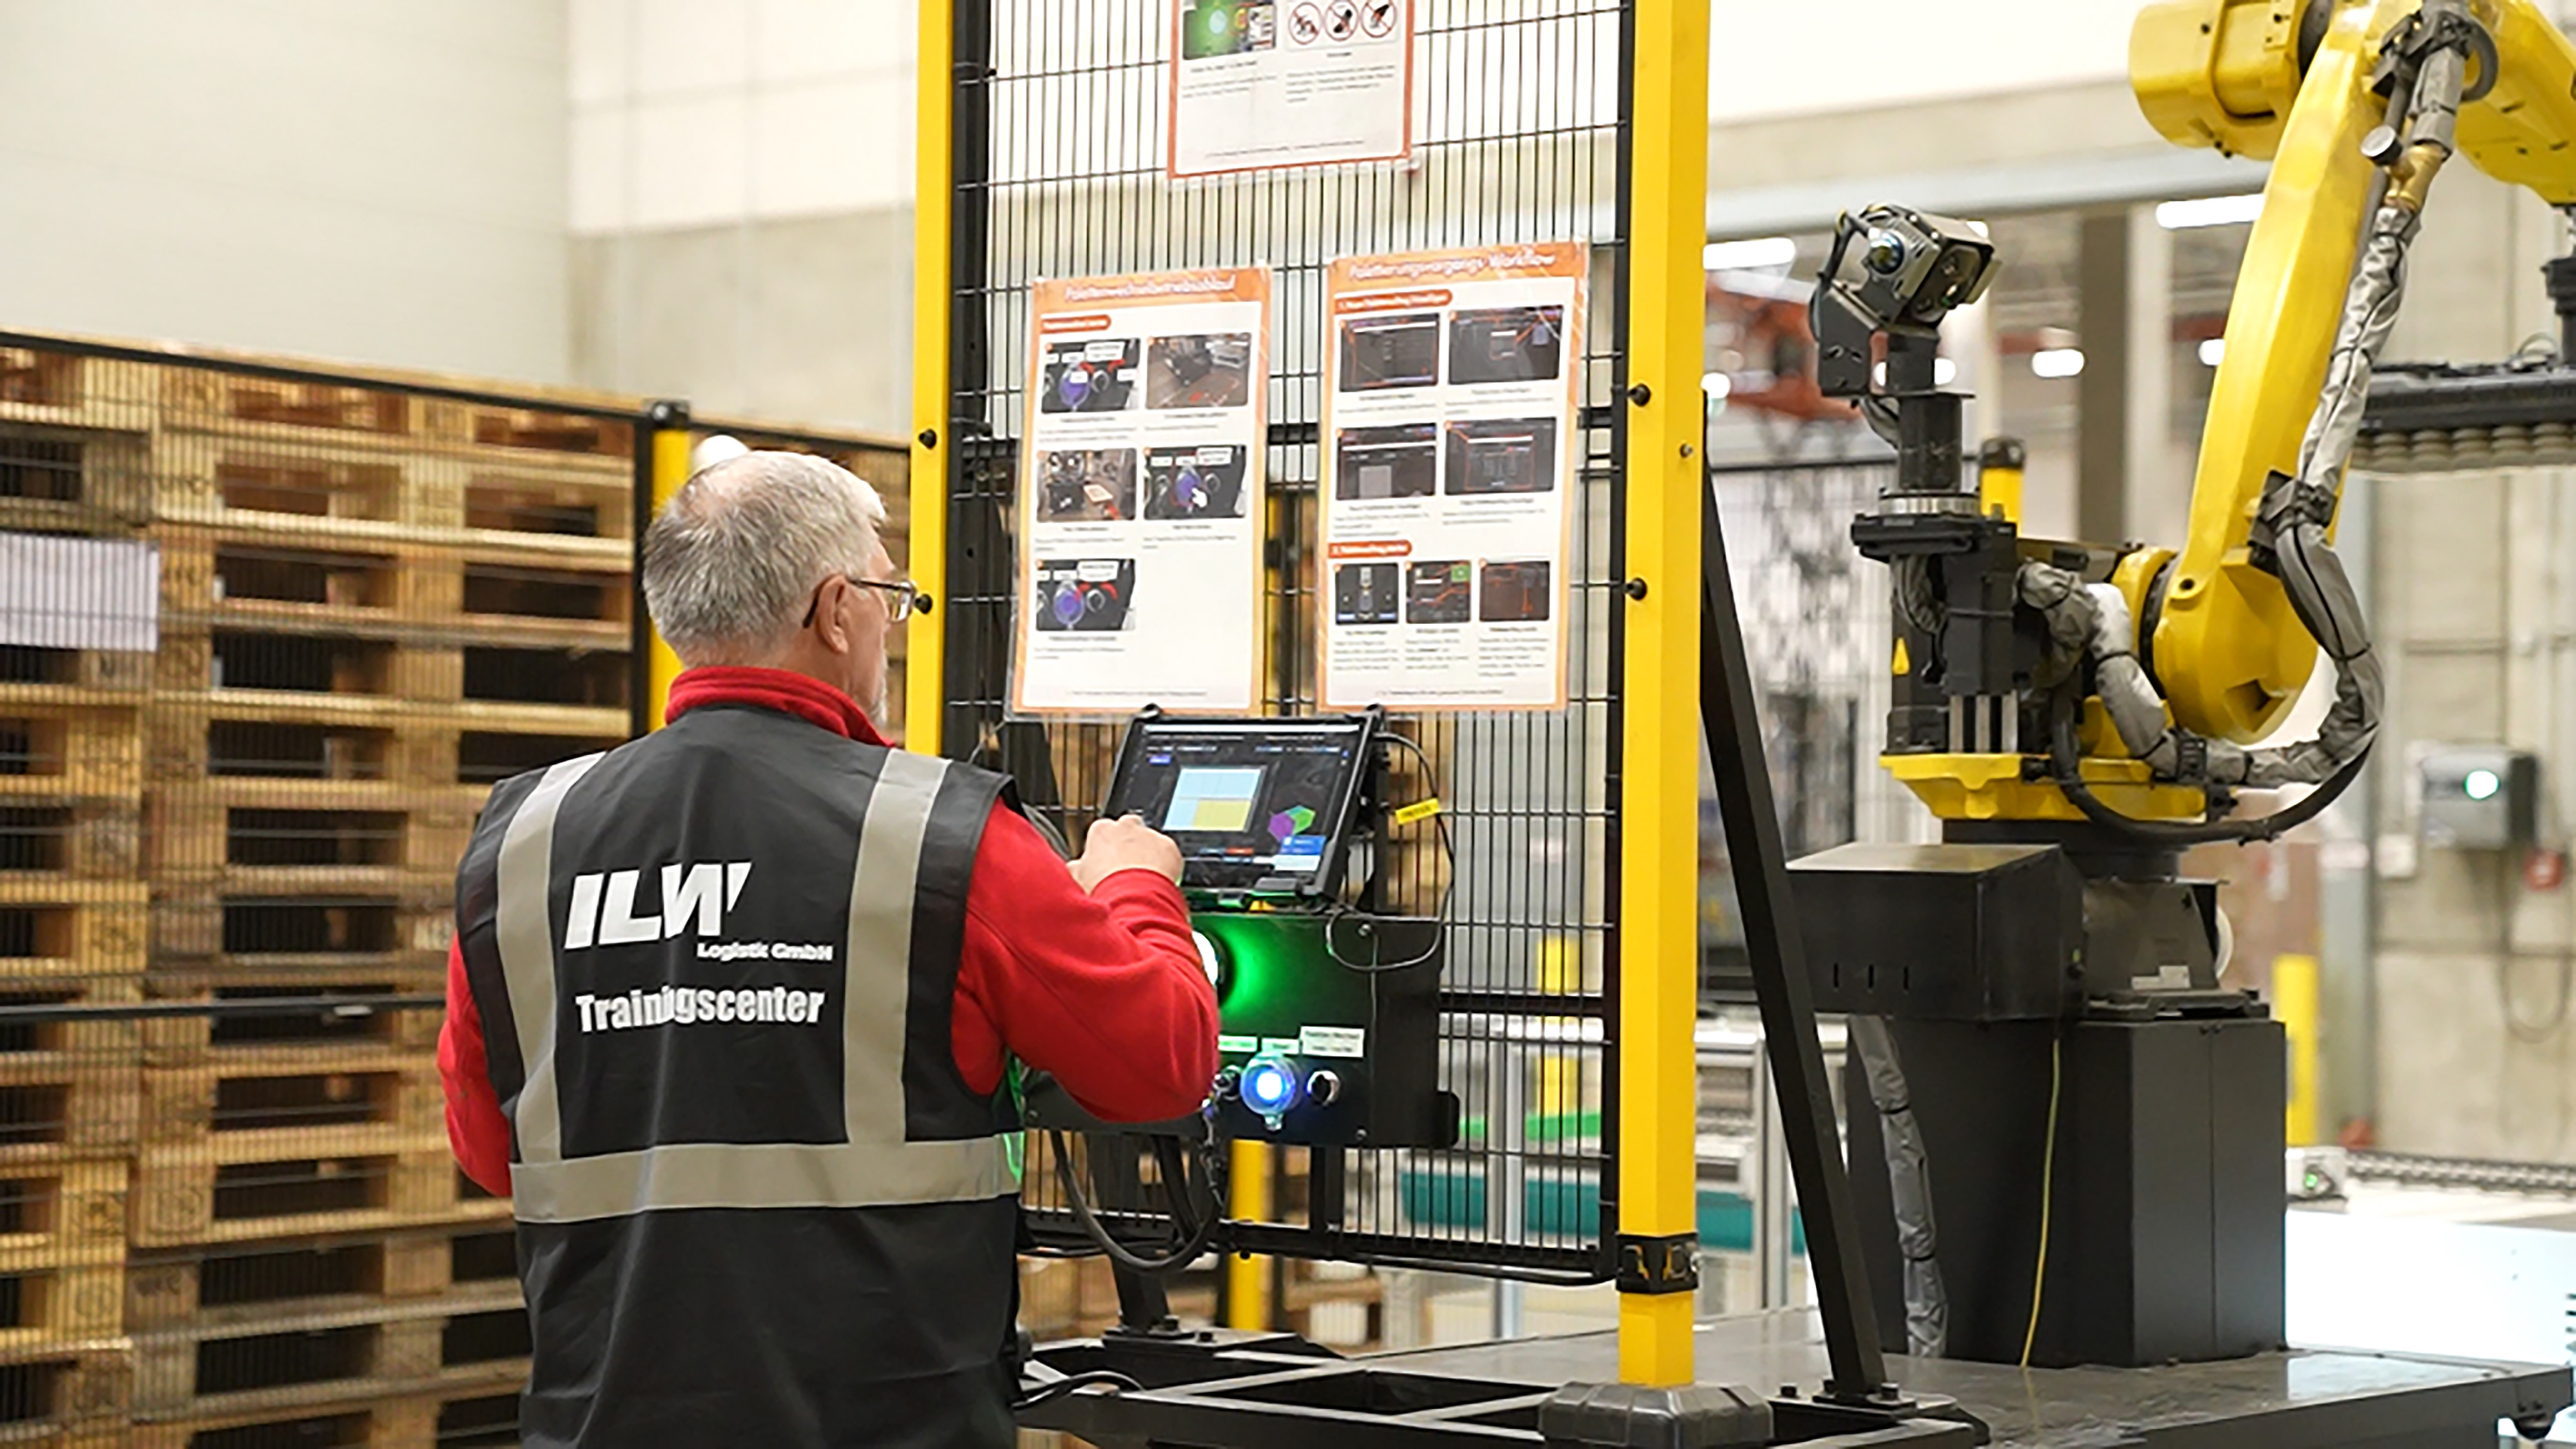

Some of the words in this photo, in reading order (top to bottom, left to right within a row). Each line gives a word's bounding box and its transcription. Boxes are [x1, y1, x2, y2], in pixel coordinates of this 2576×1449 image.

[565, 862, 751, 950] ILW
[697, 942, 768, 962] Logistik
[771, 943, 833, 961] GmbH
